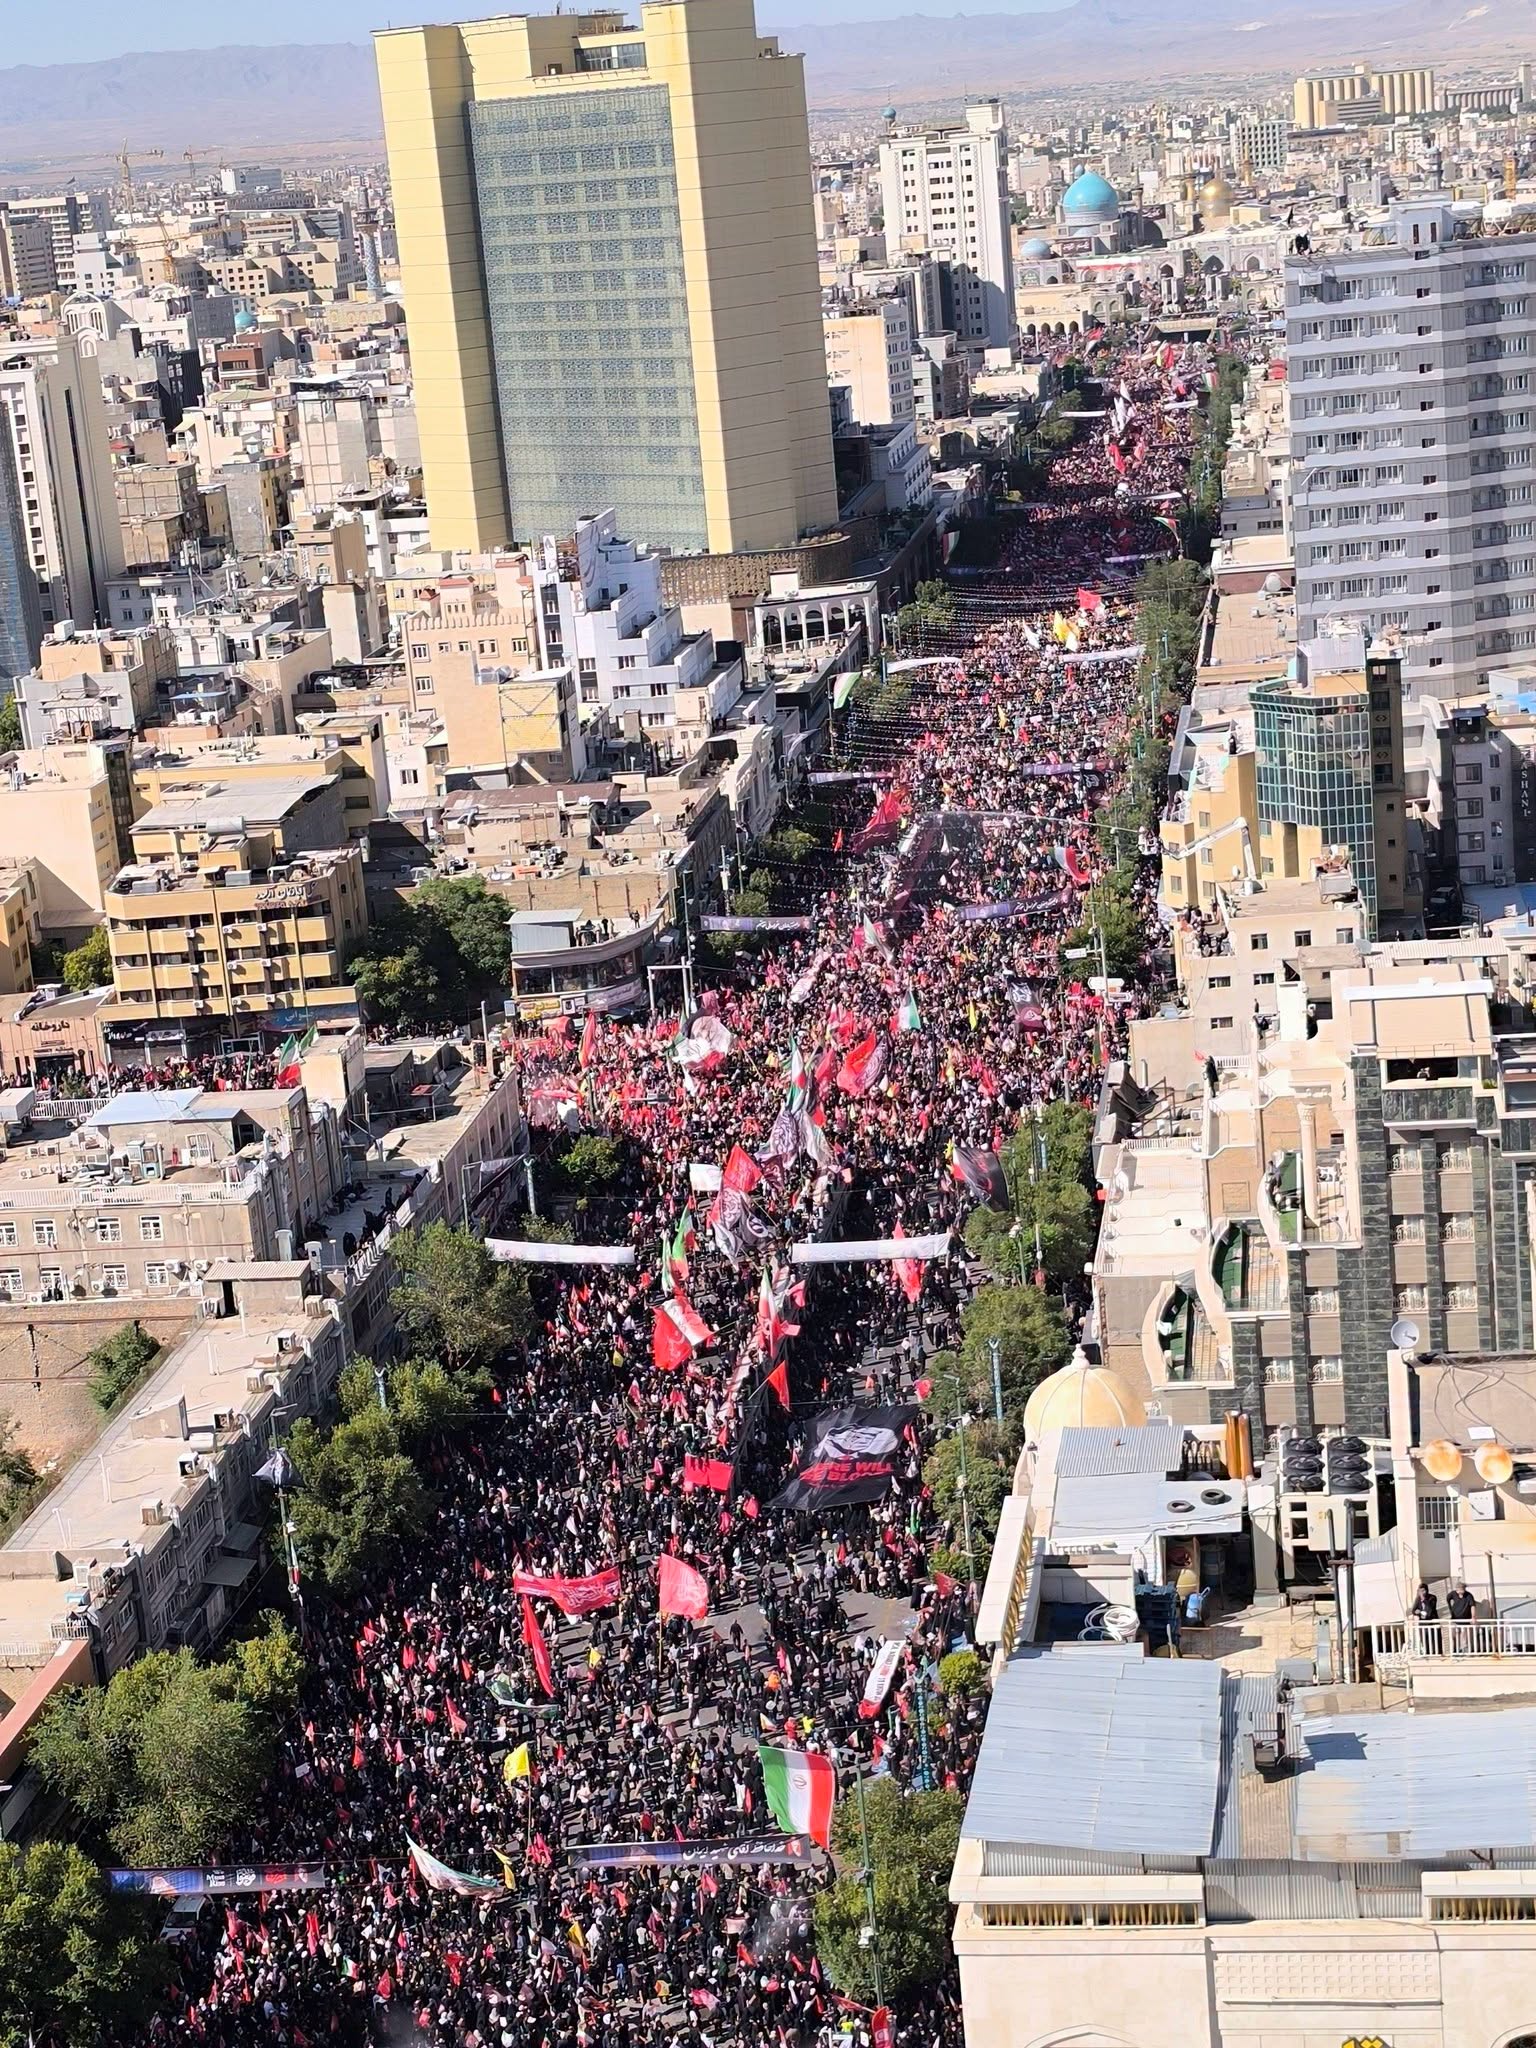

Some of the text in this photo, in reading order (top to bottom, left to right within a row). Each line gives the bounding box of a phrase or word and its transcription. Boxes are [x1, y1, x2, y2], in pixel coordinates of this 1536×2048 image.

[31, 1020, 70, 1032] داروخانه
[856, 1462, 894, 1472] WILL
[682, 1839, 785, 1861] خداحافظ آقای شهید ایران
